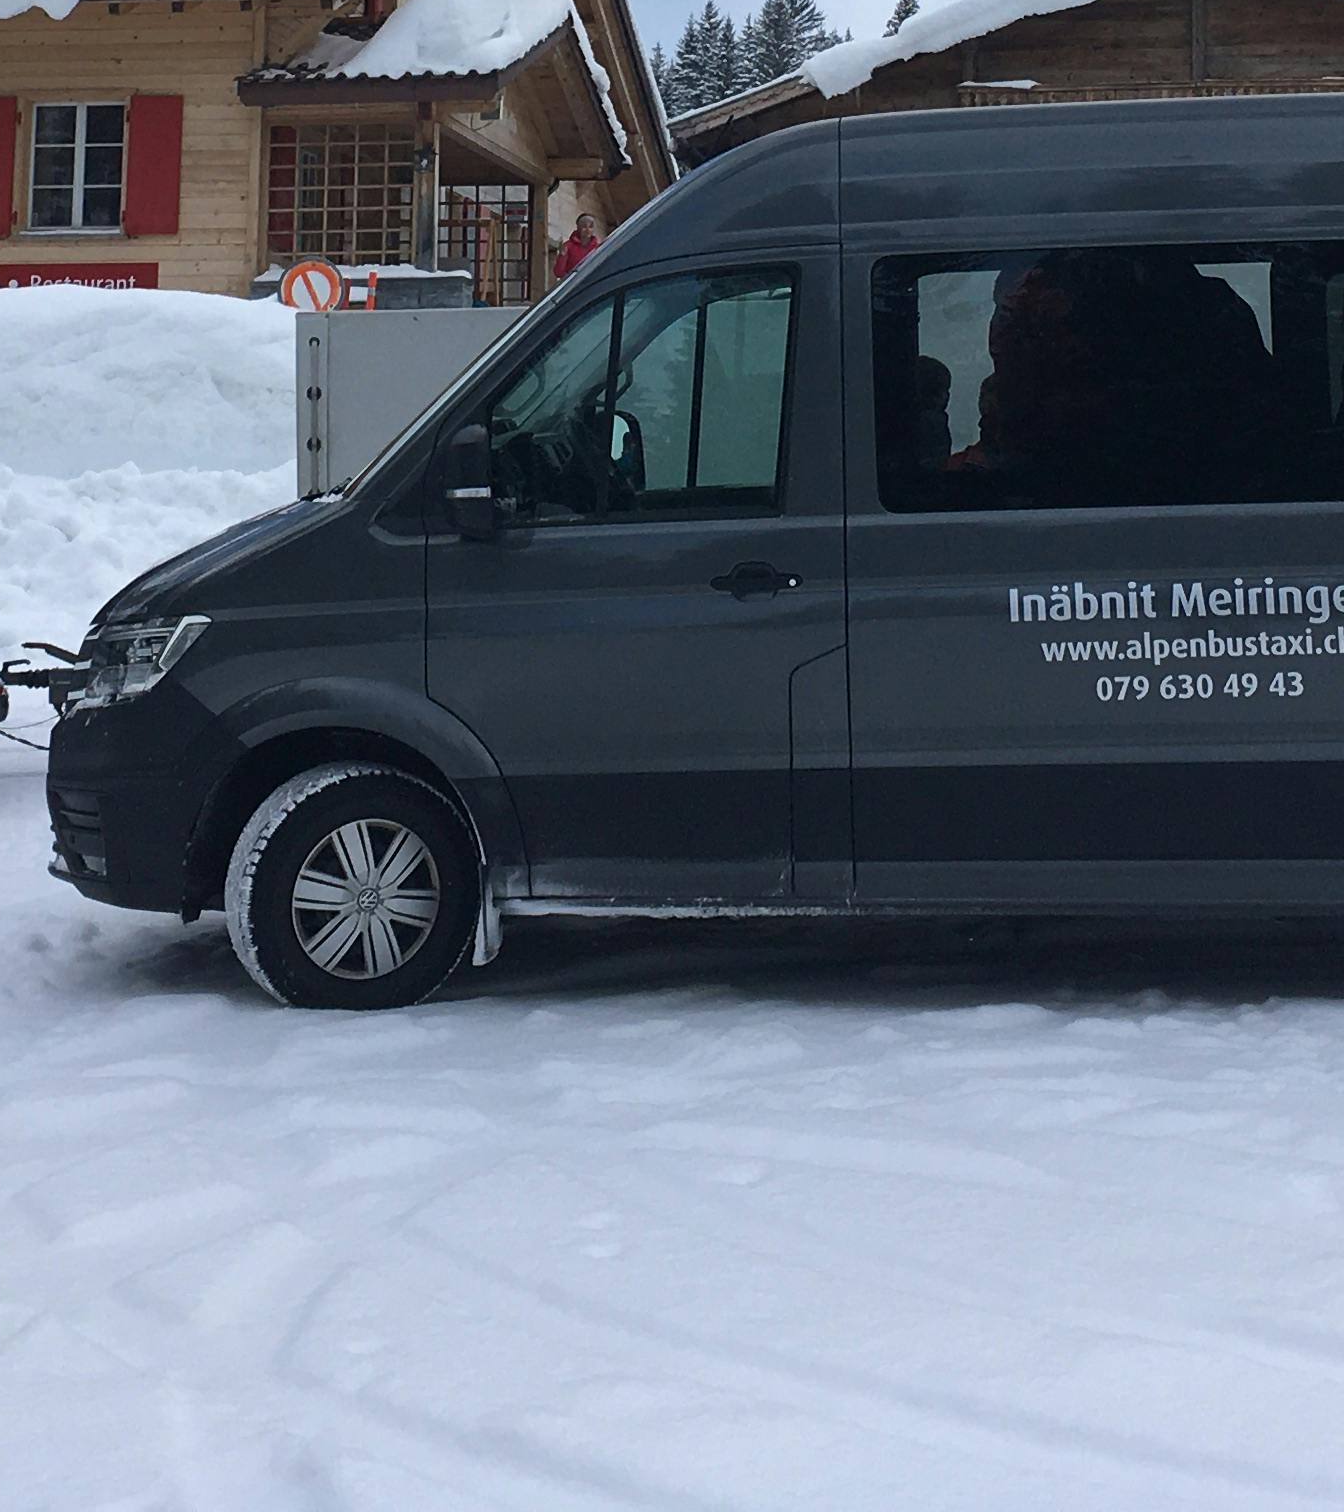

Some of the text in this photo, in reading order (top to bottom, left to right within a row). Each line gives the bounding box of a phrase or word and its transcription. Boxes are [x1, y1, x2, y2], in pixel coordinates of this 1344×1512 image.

[1009, 581, 1156, 622] Inäbnit
[1096, 672, 1305, 701] 079 630 49 43
